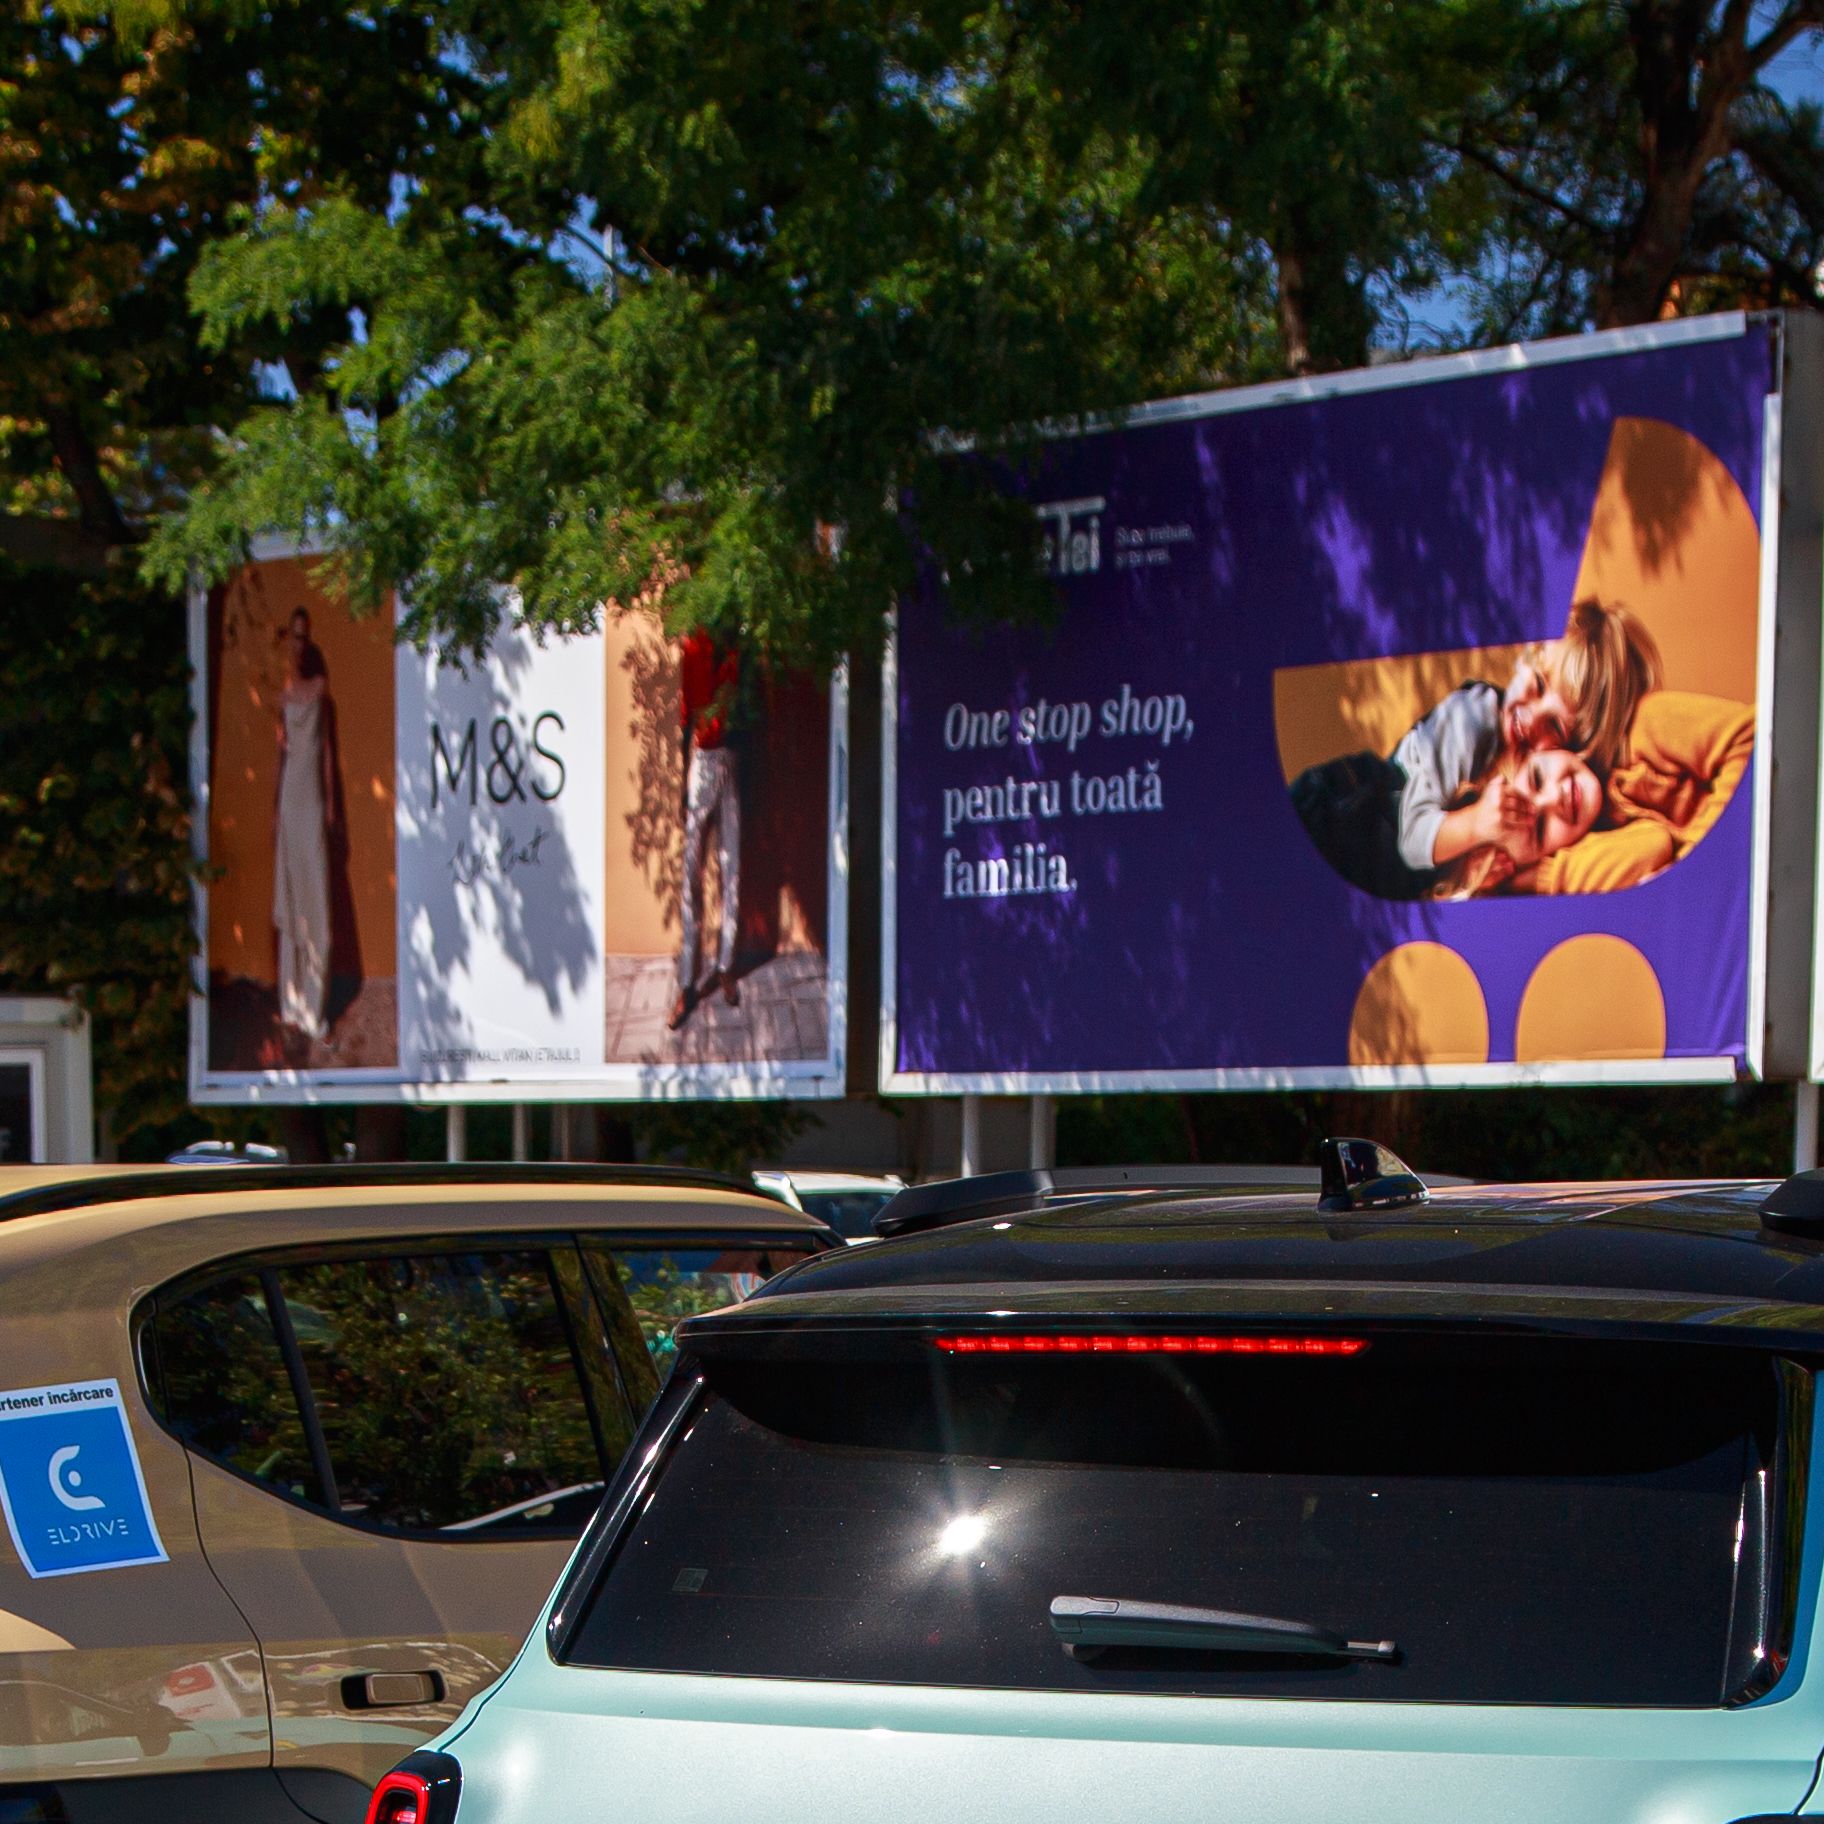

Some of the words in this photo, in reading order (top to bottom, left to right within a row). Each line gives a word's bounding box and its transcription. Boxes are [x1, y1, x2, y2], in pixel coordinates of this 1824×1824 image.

[944, 702, 1010, 751] One
[1016, 698, 1091, 753] stop
[1100, 683, 1195, 747] shop,
[430, 710, 566, 809] M&S
[943, 776, 1061, 838] pentru
[1070, 758, 1164, 815] toată
[944, 842, 1078, 899] familia.
[47, 1385, 114, 1405] încărcare
[47, 1518, 129, 1545] ELDRIVE
